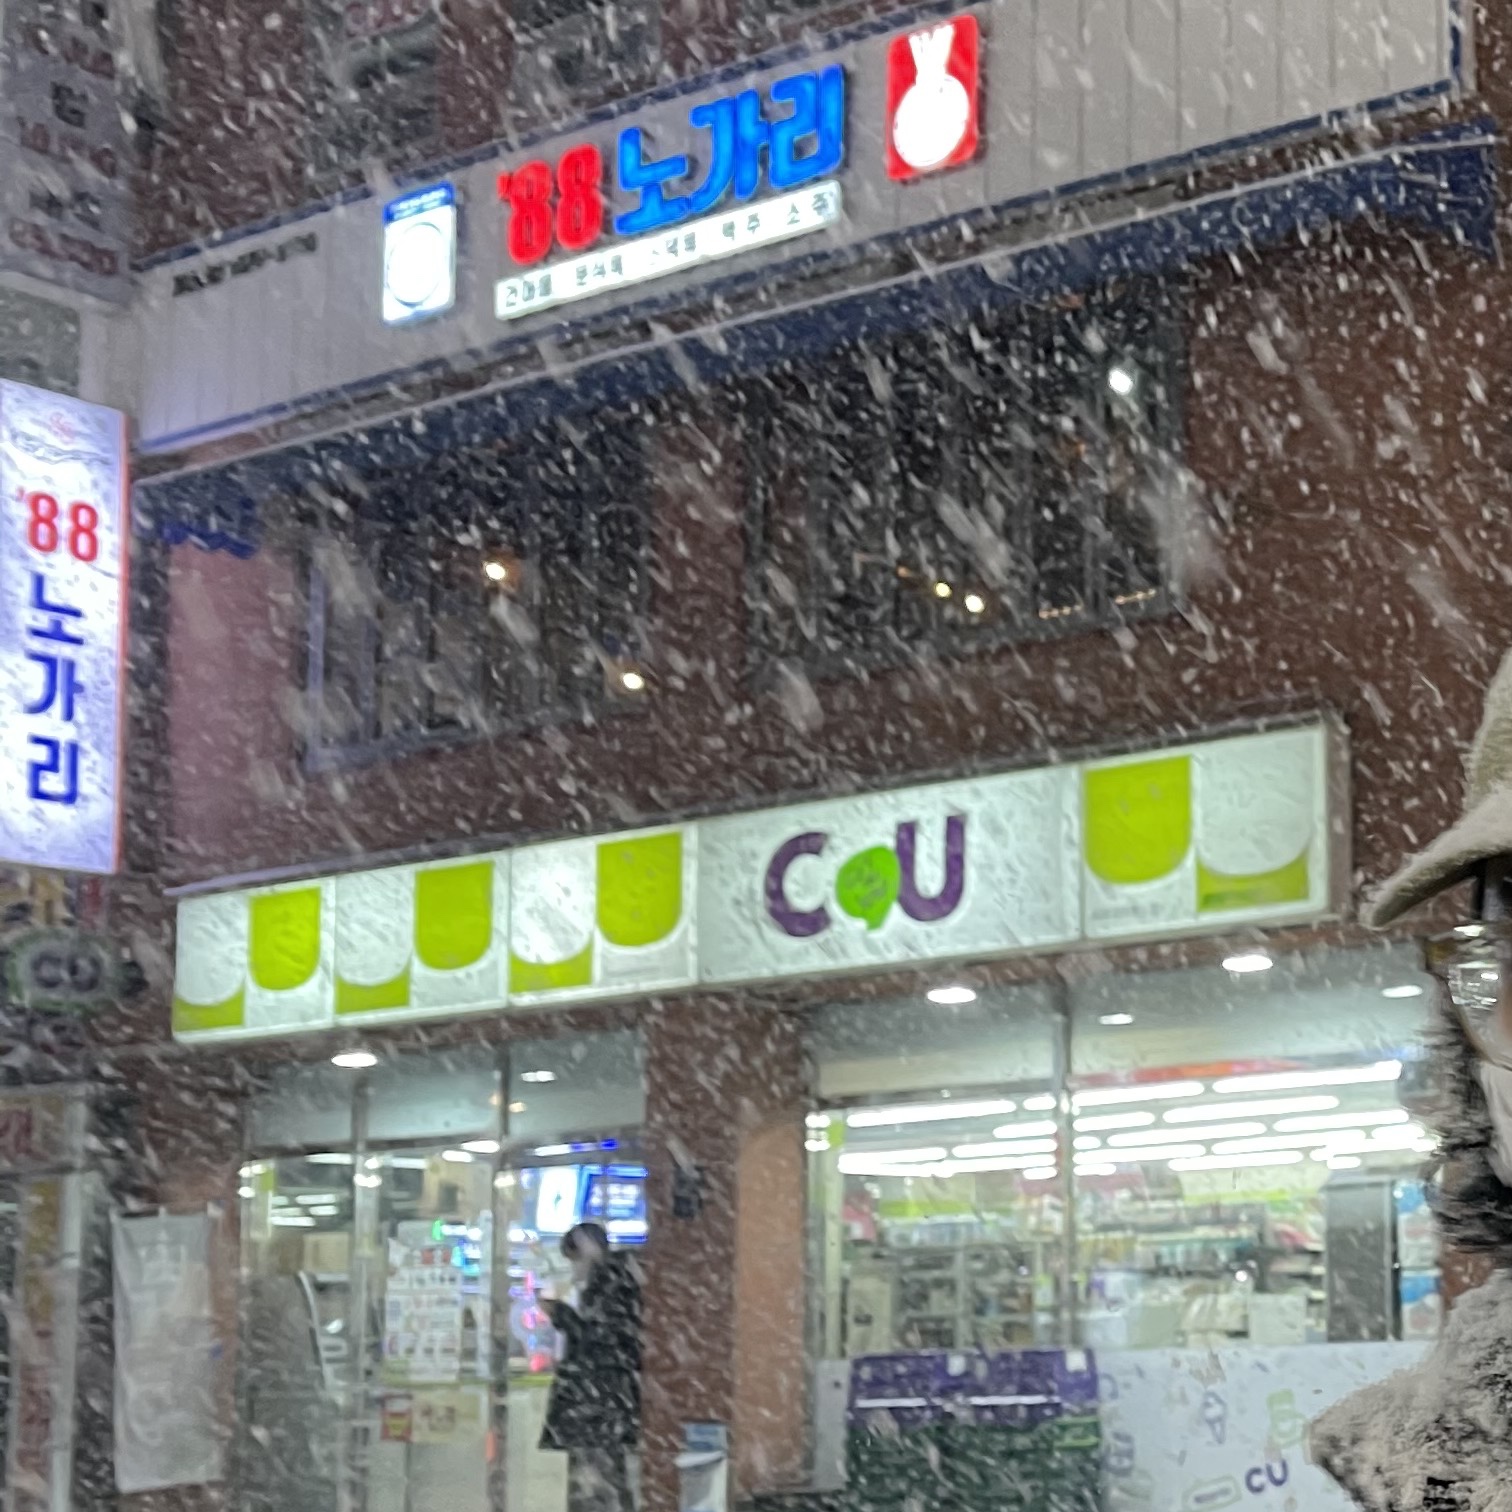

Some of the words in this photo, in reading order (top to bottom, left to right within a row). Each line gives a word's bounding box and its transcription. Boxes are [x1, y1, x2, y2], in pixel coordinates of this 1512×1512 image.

[614, 63, 846, 235] 노가리
[24, 570, 85, 805] 노가리
[764, 813, 967, 938] CU
[1244, 1458, 1289, 1494] CU
